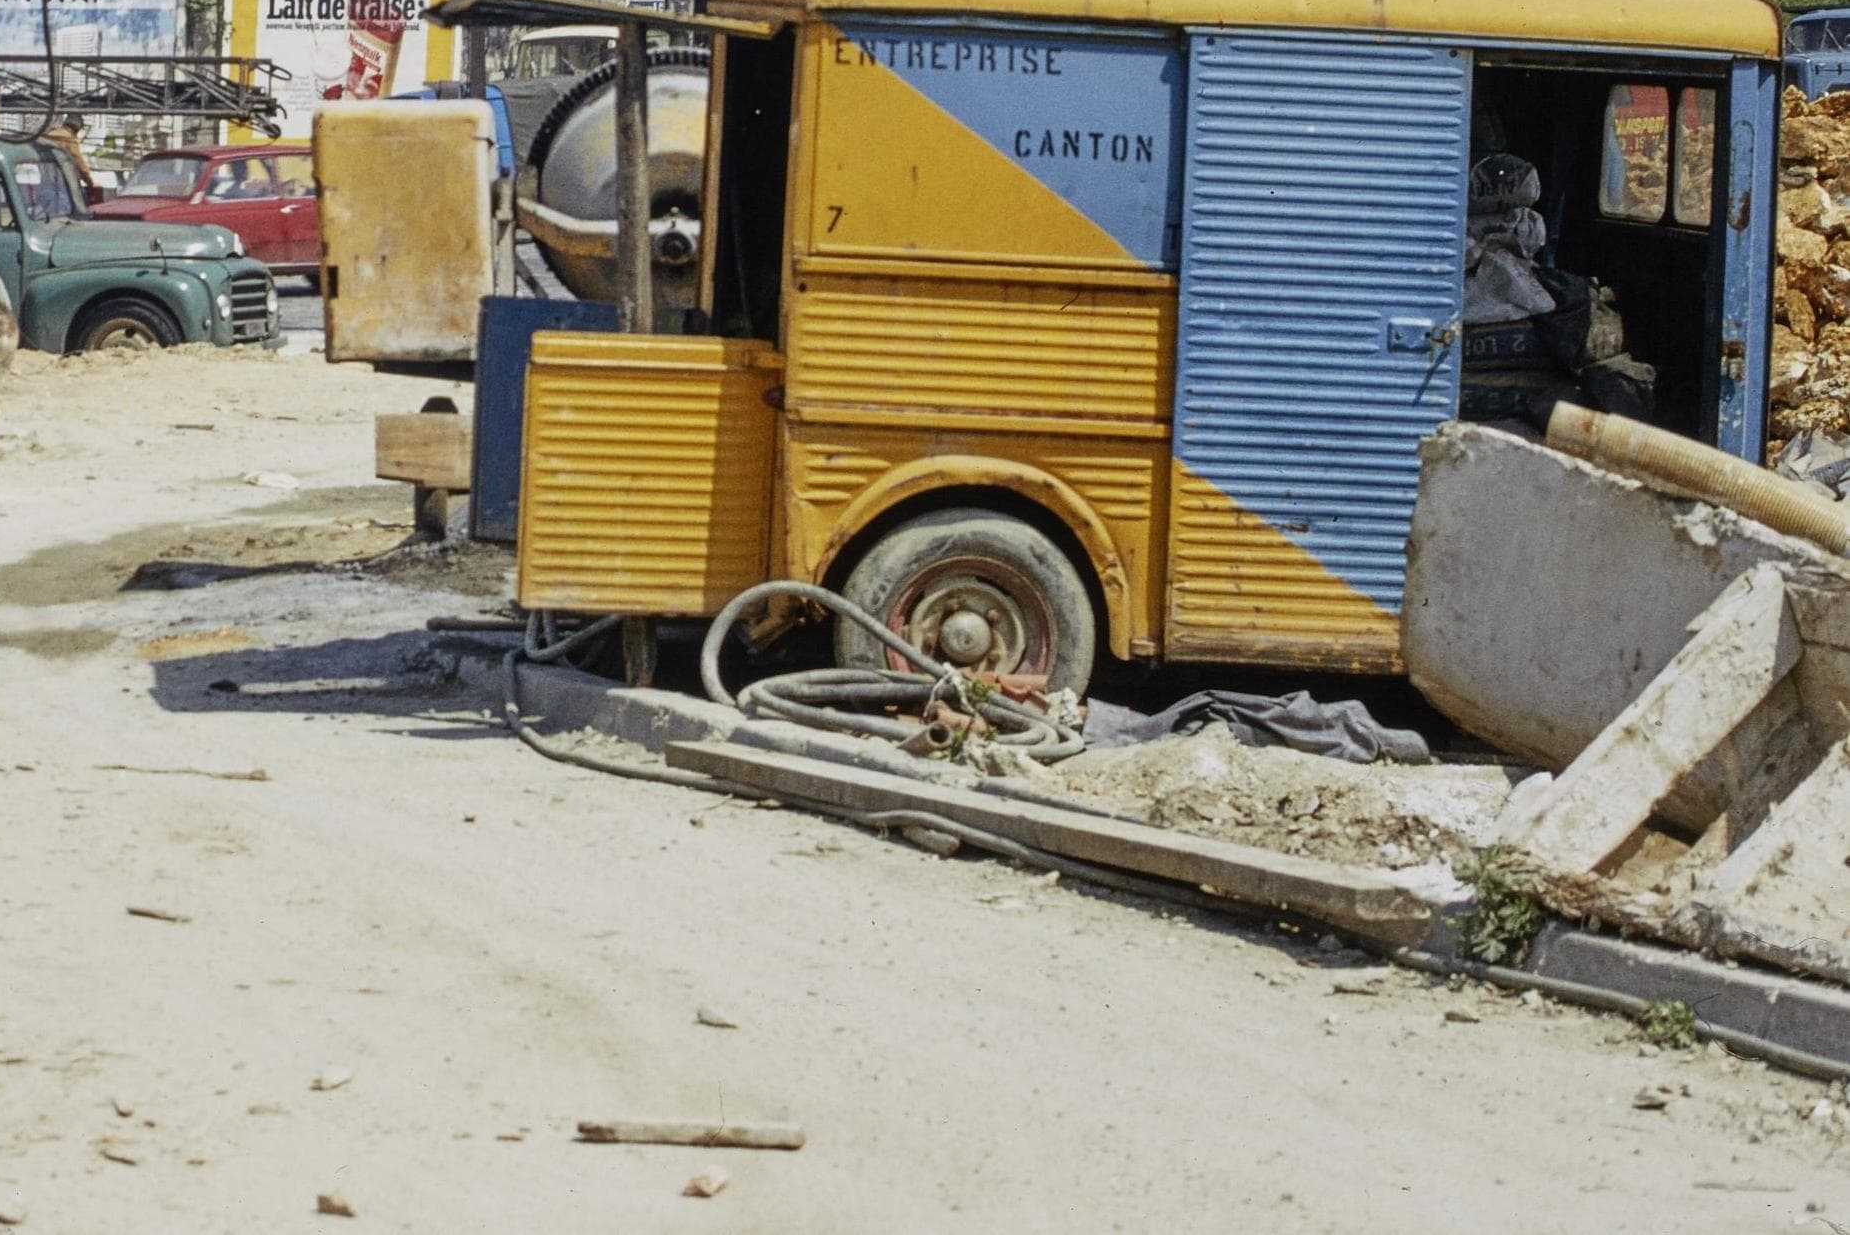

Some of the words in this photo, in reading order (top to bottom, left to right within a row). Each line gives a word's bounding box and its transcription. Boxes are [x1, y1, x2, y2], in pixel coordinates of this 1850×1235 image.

[836, 38, 1063, 76] ENTREPRISE
[1015, 130, 1154, 163] CANTON
[827, 206, 844, 233] 7
